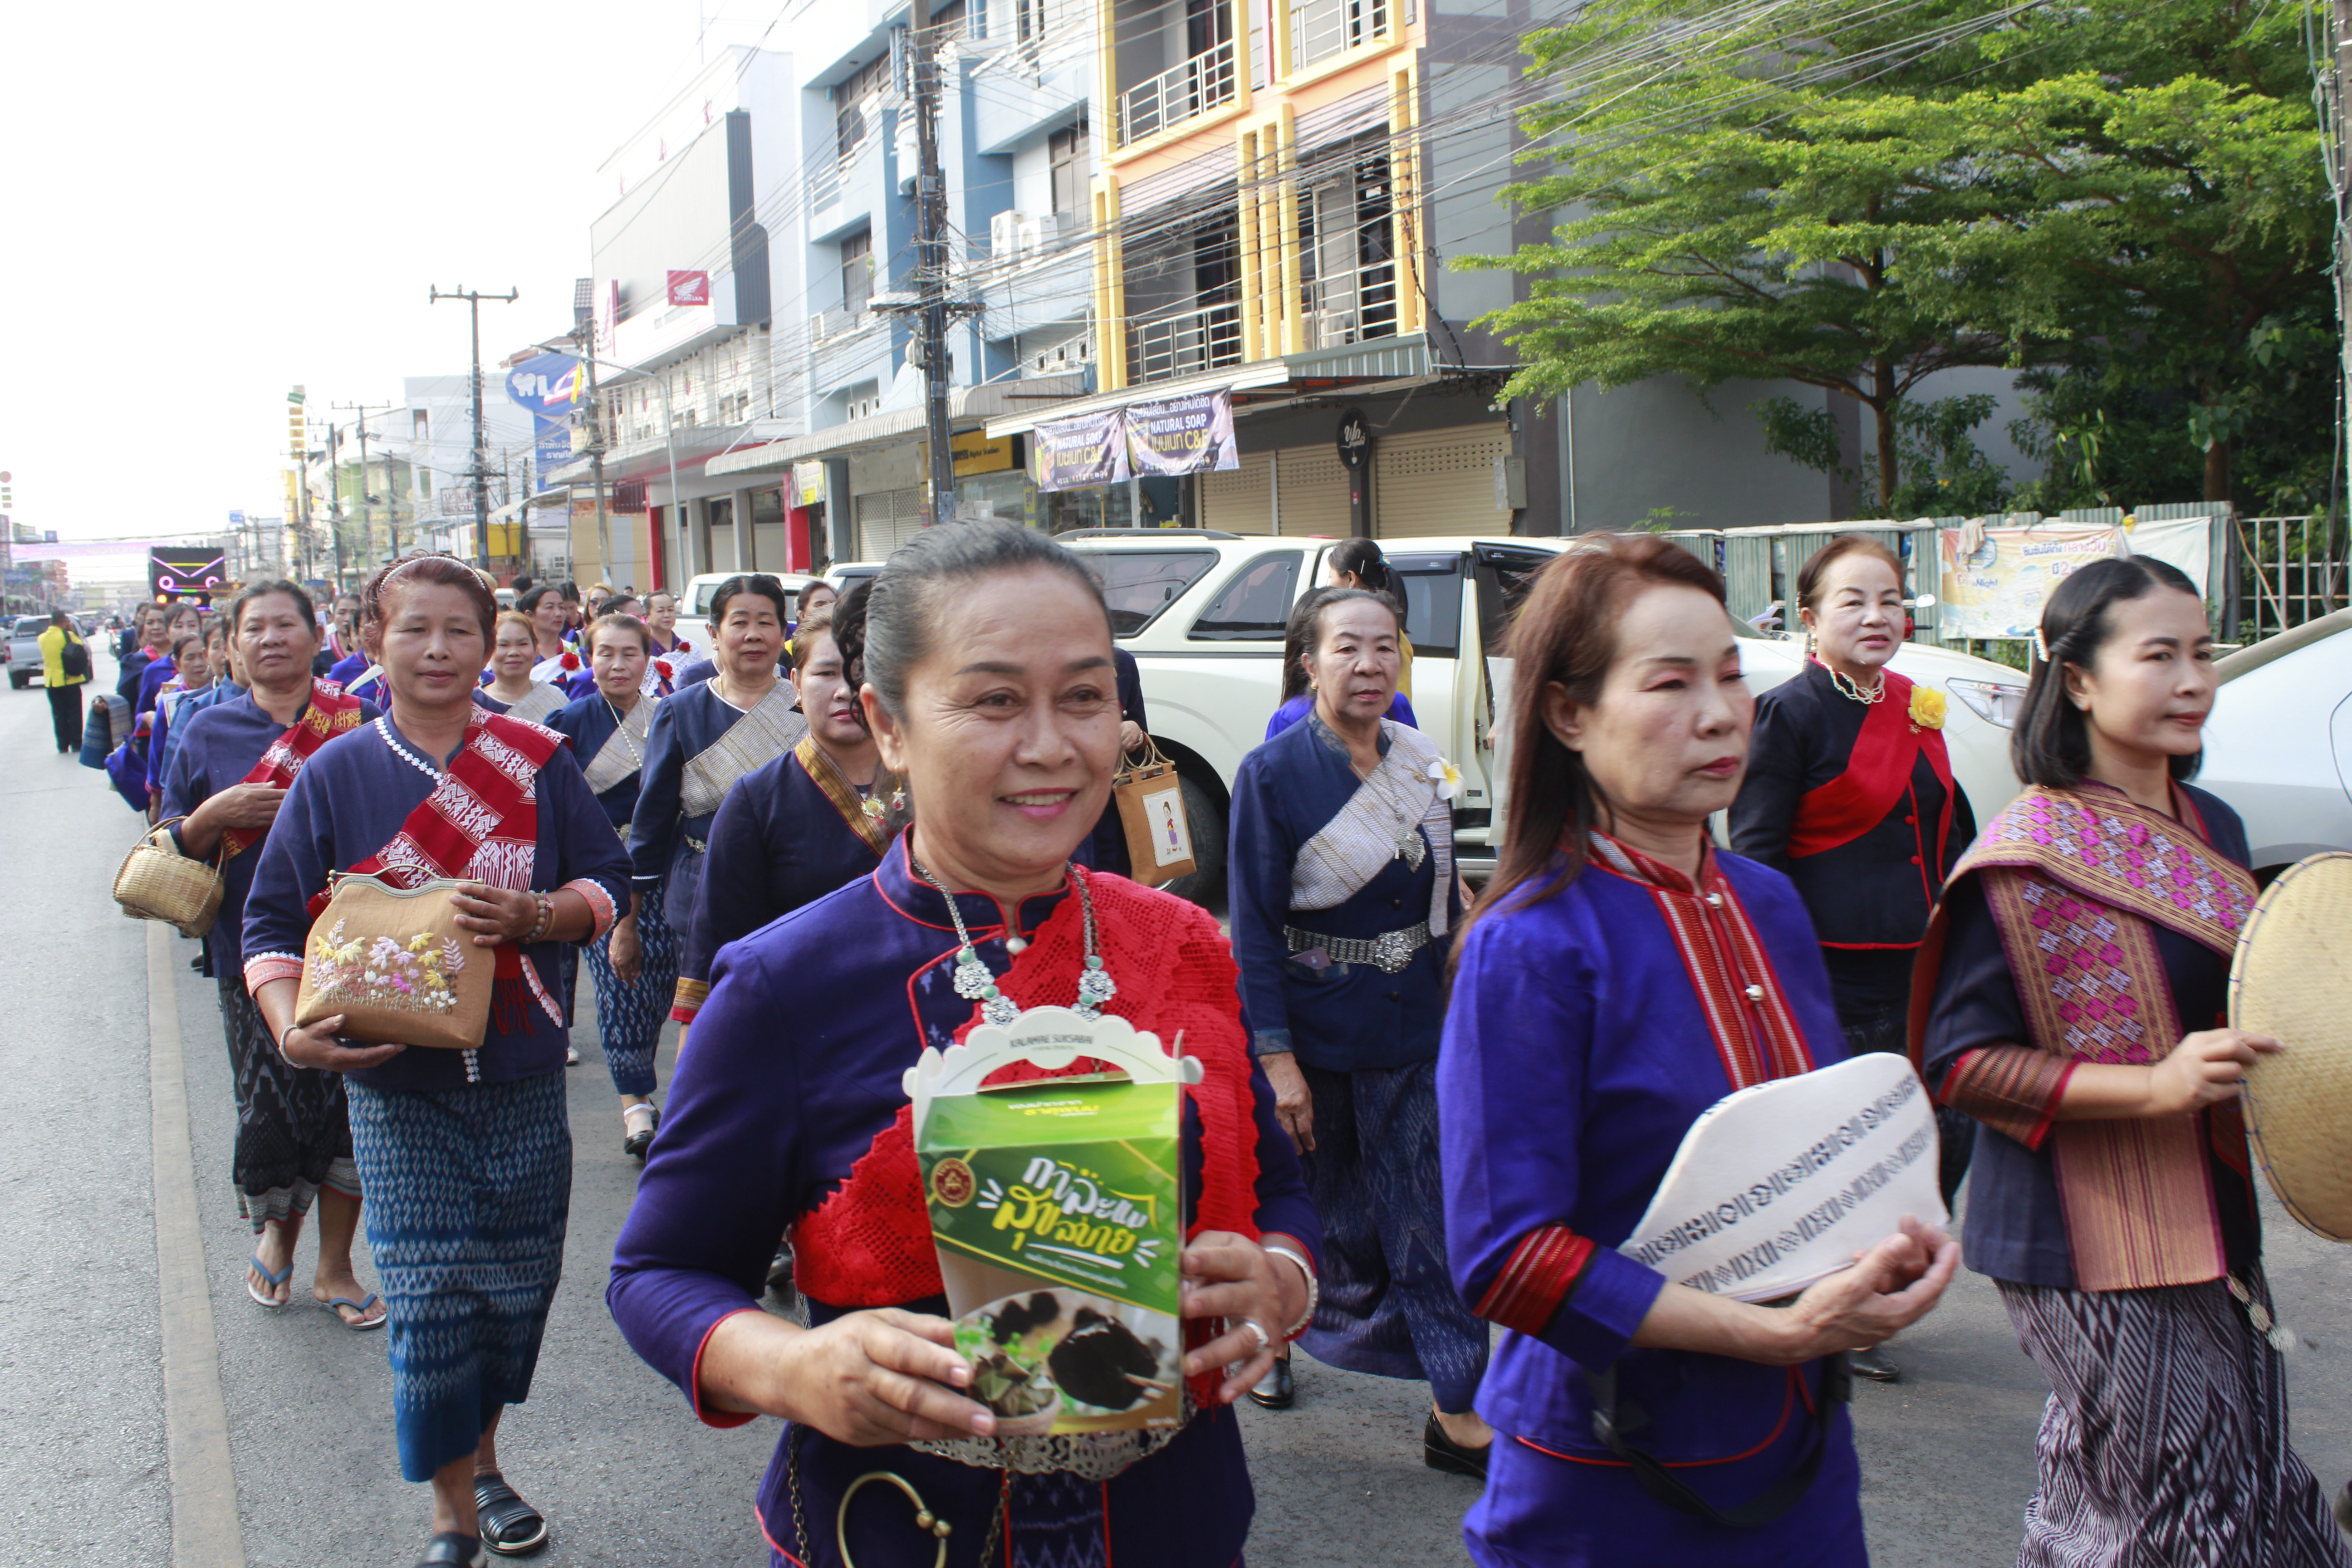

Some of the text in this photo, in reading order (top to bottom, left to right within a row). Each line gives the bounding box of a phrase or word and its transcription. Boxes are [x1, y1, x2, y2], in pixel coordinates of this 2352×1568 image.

[1150, 413, 1207, 434] NATURAL SOAP
[1057, 431, 1103, 450] NATURAL SOAP
[1185, 429, 1209, 450] C&E
[1083, 445, 1104, 465] C&E
[2061, 561, 2070, 576] 2
[1022, 1156, 1150, 1229] กาละแม
[991, 1184, 1137, 1256] สุขสบาย
